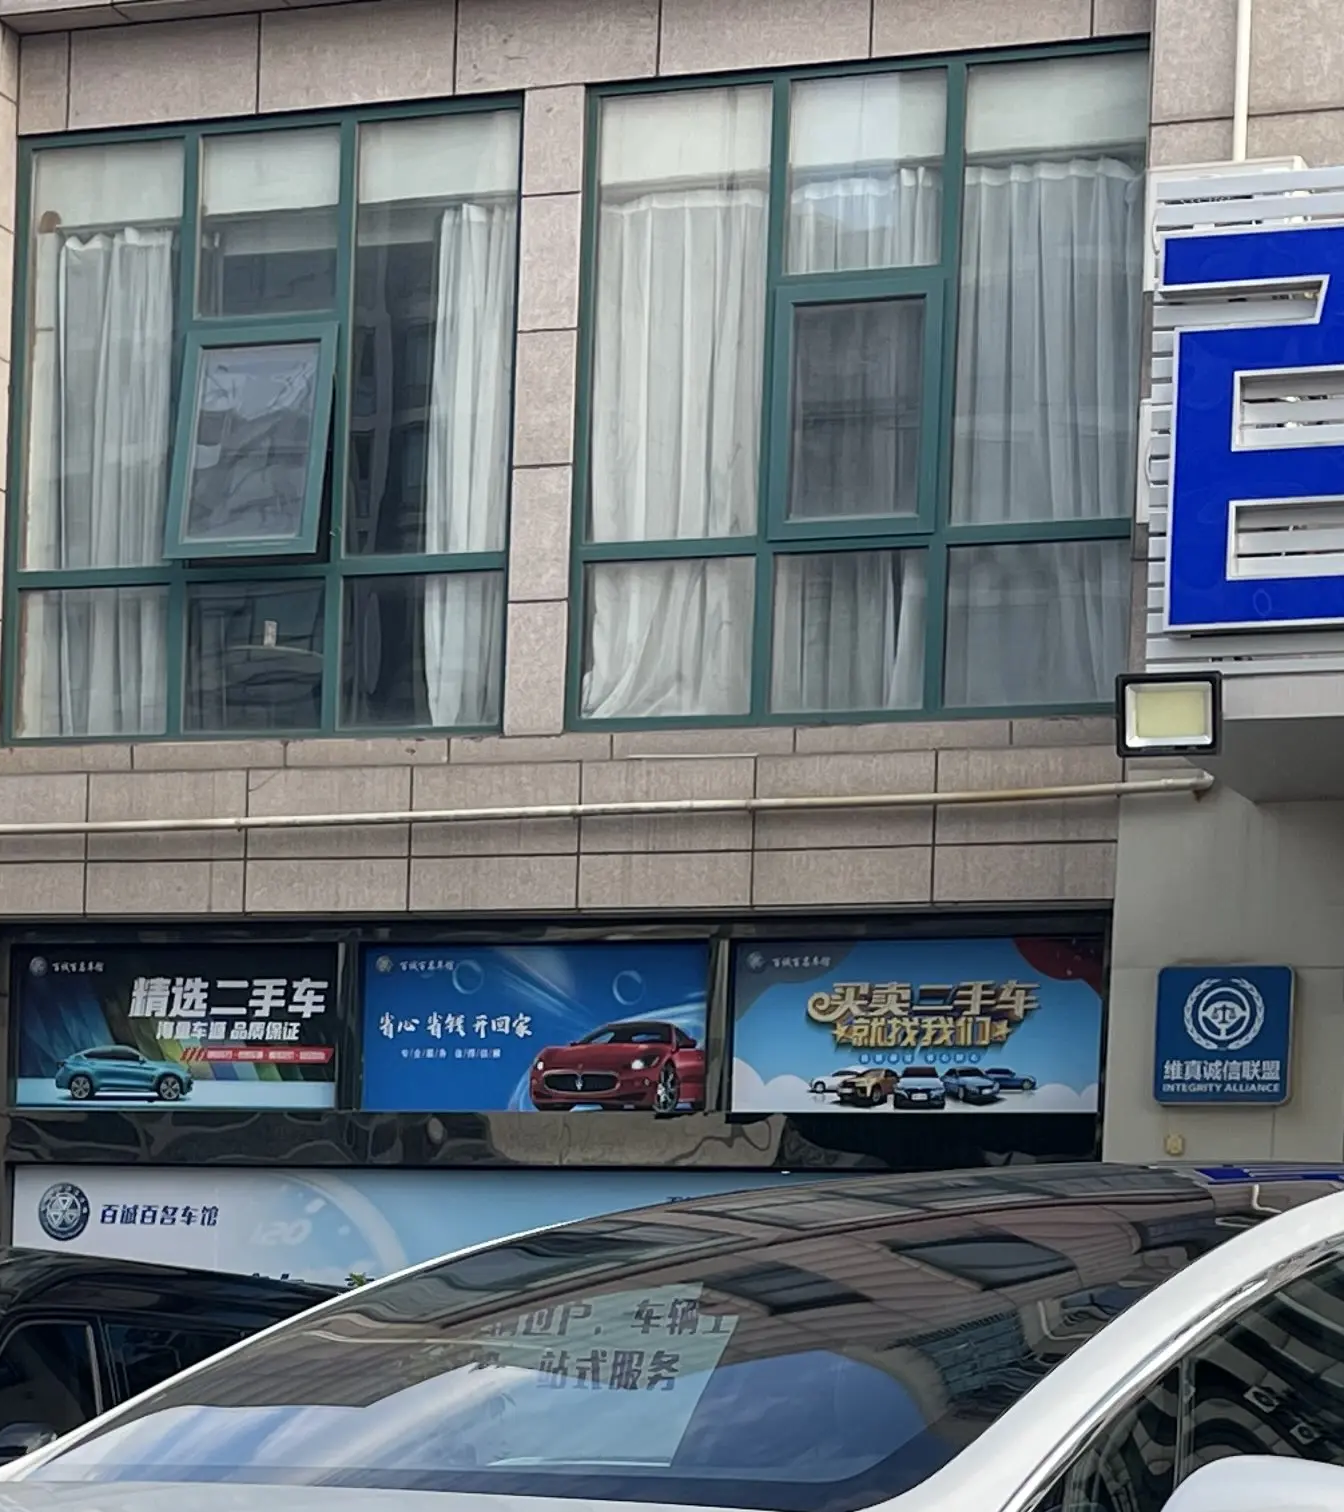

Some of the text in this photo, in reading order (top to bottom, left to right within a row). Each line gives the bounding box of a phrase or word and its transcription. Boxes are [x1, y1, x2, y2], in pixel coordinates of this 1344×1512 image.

[128, 976, 329, 1019] 精选二手车
[807, 979, 1041, 1022] 买卖二手车
[378, 1012, 420, 1040] 省心
[851, 1015, 992, 1048] 就找我们
[1163, 1060, 1281, 1081] 维真诚信联盟
[1162, 1083, 1280, 1093] INTEGRITY ALLIANCE
[100, 1204, 219, 1227] 百诚百名车馆
